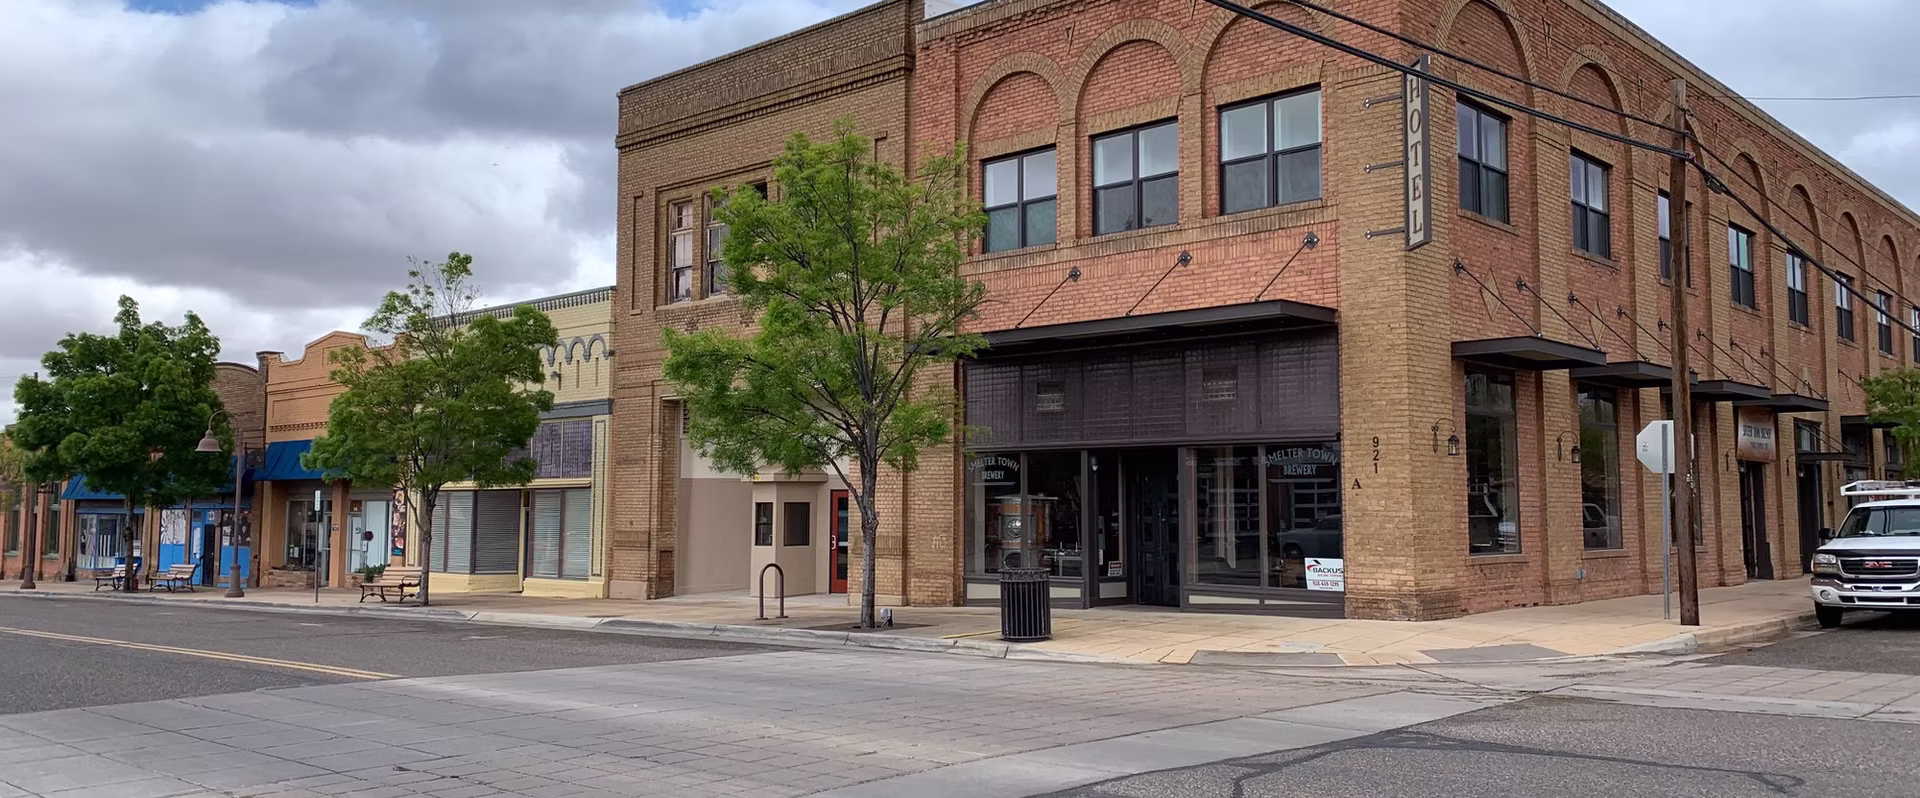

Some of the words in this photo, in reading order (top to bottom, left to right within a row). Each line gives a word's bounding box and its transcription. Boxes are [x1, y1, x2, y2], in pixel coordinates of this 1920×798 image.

[1408, 77, 1422, 234] HOTEL
[968, 457, 996, 472] SMELTER
[997, 457, 1020, 472] TOWN
[1265, 448, 1304, 467] SMELTER
[1307, 448, 1338, 466] TOWN
[1372, 436, 1380, 474] 921
[1283, 464, 1317, 476] BREWERY
